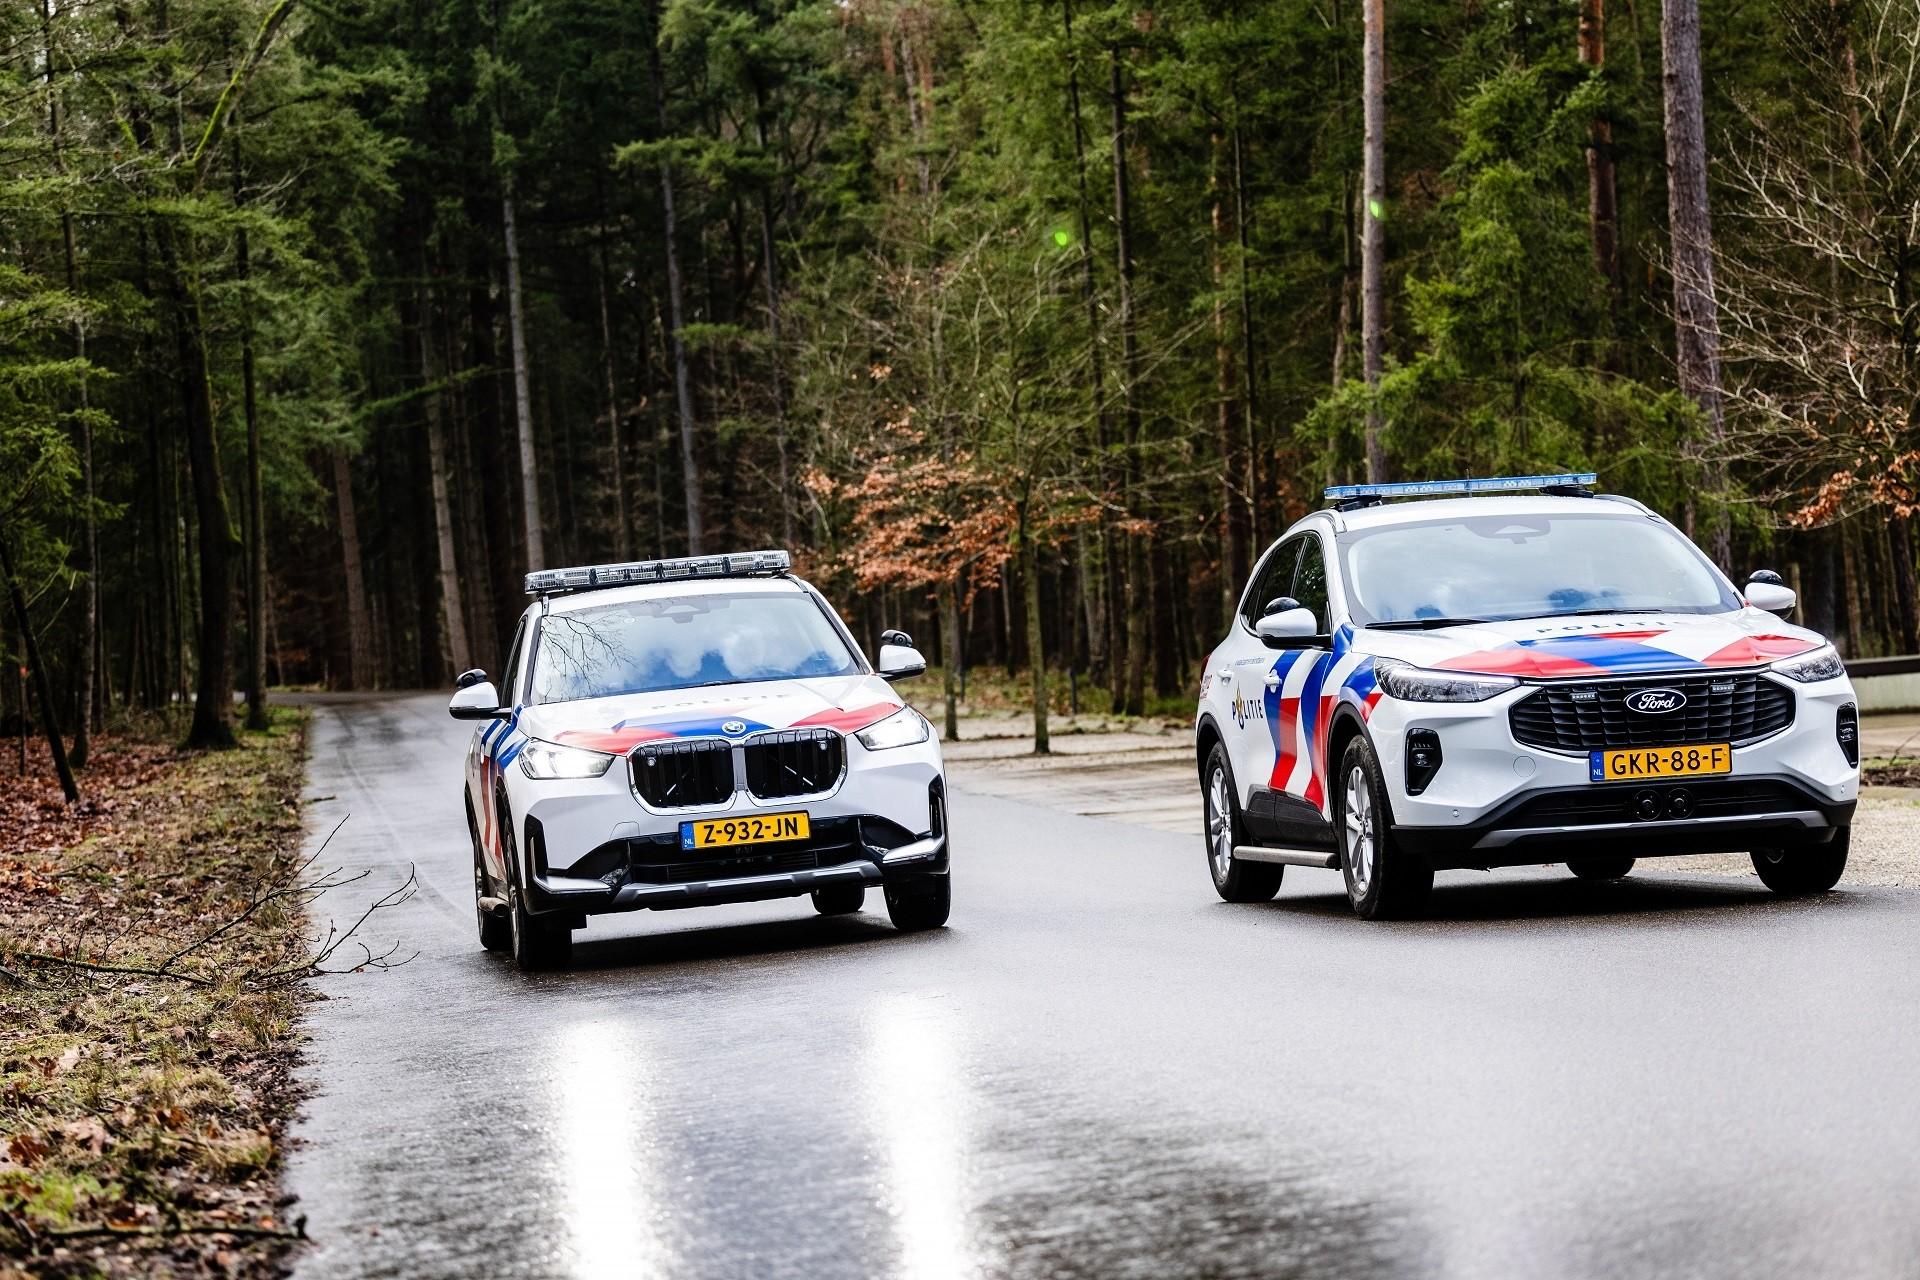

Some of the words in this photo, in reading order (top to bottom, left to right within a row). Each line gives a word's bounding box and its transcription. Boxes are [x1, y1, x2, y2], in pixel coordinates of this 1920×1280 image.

[1536, 621, 1691, 633] POLITI
[1638, 693, 1676, 710] Ford
[1232, 698, 1264, 730] POLITIE
[1593, 768, 1603, 776] NL
[1611, 748, 1722, 775] GKR-88-F
[703, 817, 799, 844] Z-932-JN
